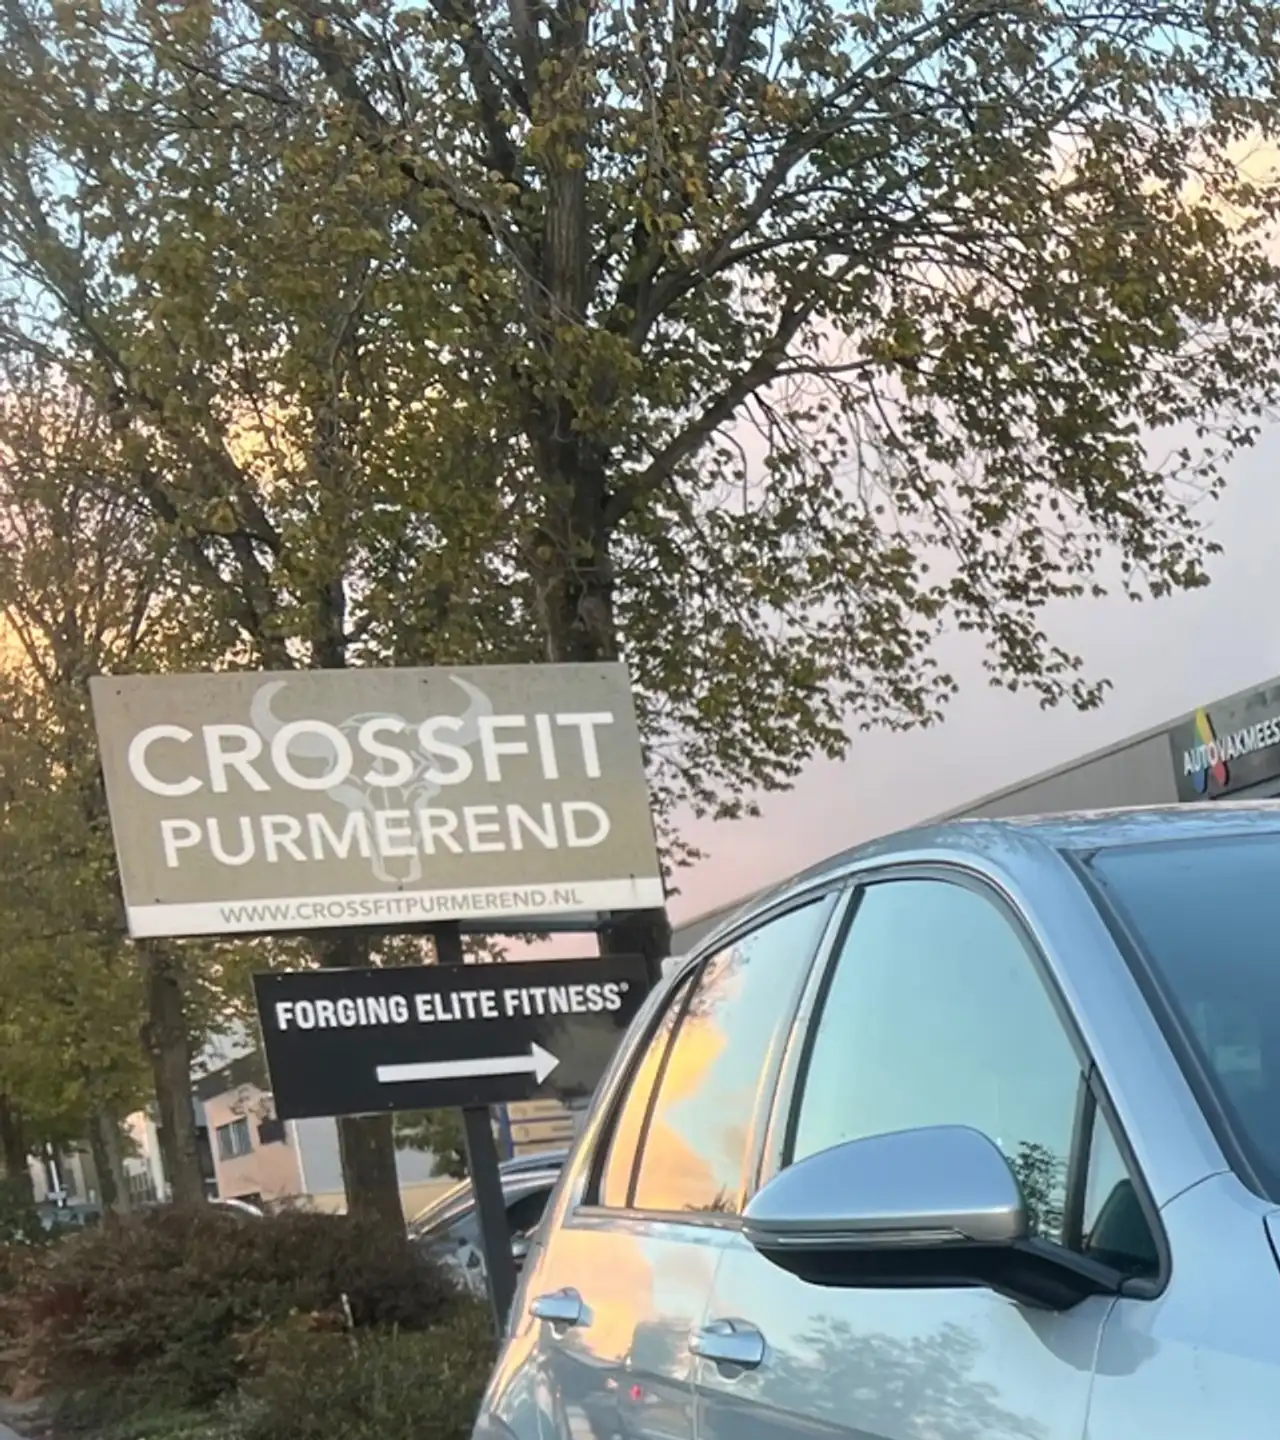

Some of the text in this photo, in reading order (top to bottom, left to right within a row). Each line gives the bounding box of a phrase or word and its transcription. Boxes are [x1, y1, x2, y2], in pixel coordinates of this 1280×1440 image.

[127, 712, 614, 797] CROSSFIT
[160, 800, 611, 868] PURMEREND
[220, 888, 583, 925] WWW.CROSSFITPURMEREND.NL
[275, 996, 409, 1030] FORGING
[414, 989, 497, 1022] ELITE
